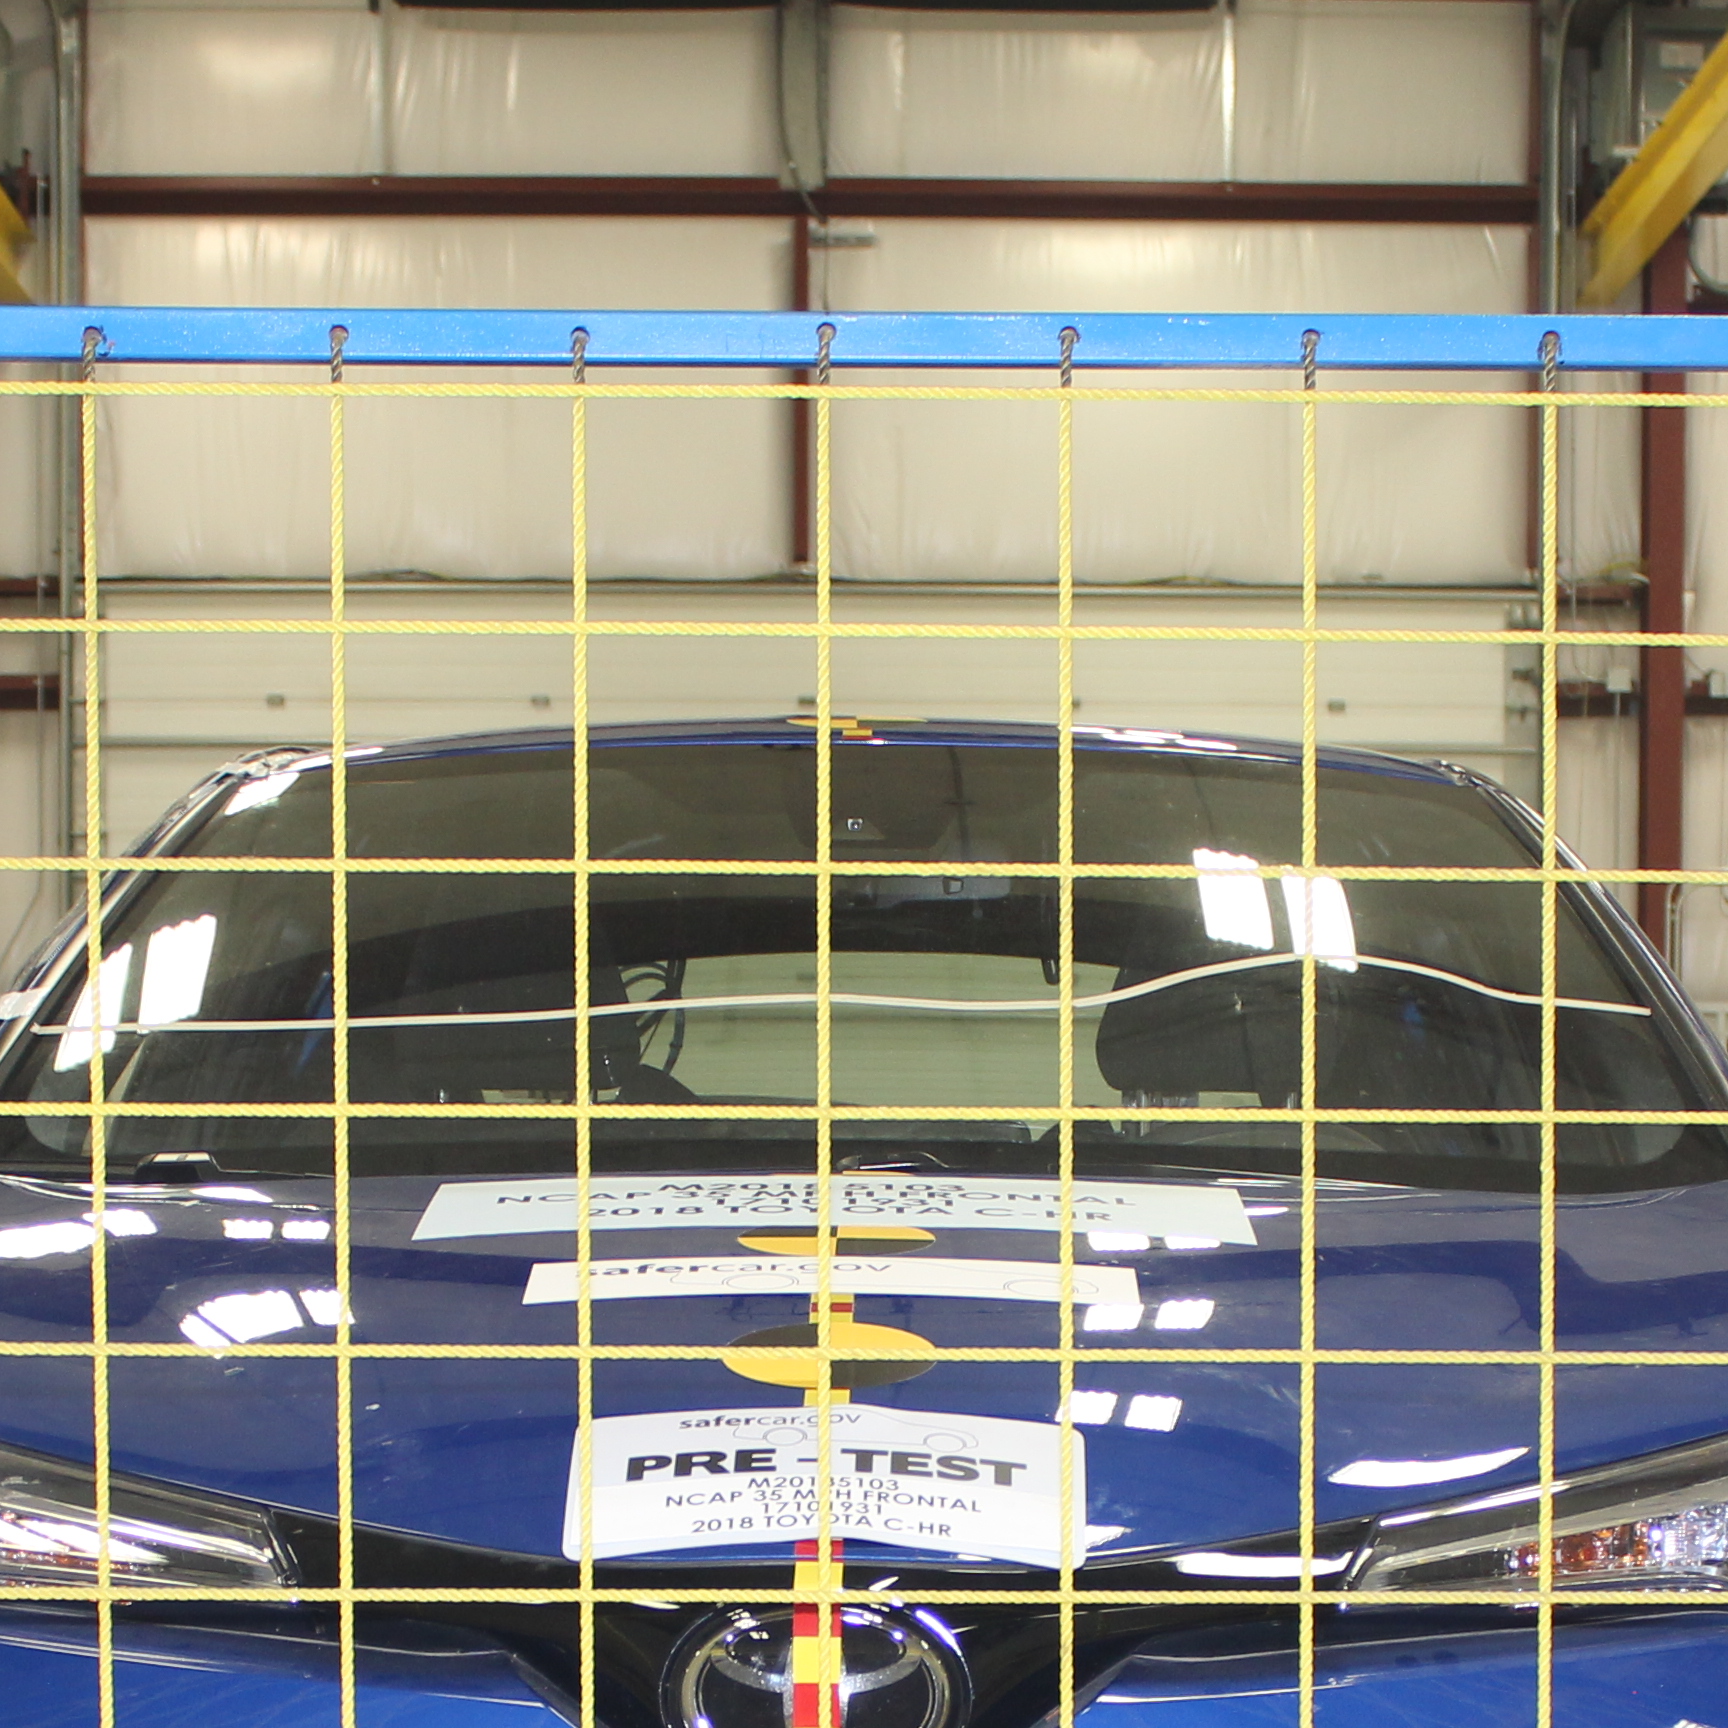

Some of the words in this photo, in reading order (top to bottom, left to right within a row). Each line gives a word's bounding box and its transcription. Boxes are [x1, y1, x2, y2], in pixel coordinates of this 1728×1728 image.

[497, 1192, 651, 1204] NCAP
[672, 1190, 731, 1199] 35
[899, 1191, 1136, 1206] FRONTAL
[588, 1206, 704, 1216] 2018
[975, 1207, 1113, 1221] C-HR
[679, 1413, 862, 1429] safercar.gov
[626, 1448, 777, 1482] PRE
[840, 1448, 1028, 1487] TEST
[665, 1491, 743, 1508] NCAP
[753, 1489, 782, 1502] 35
[793, 1488, 852, 1501] MH
[863, 1490, 982, 1513] FRONTAL
[691, 1516, 754, 1533] 2018
[883, 1518, 952, 1537] C-HR
